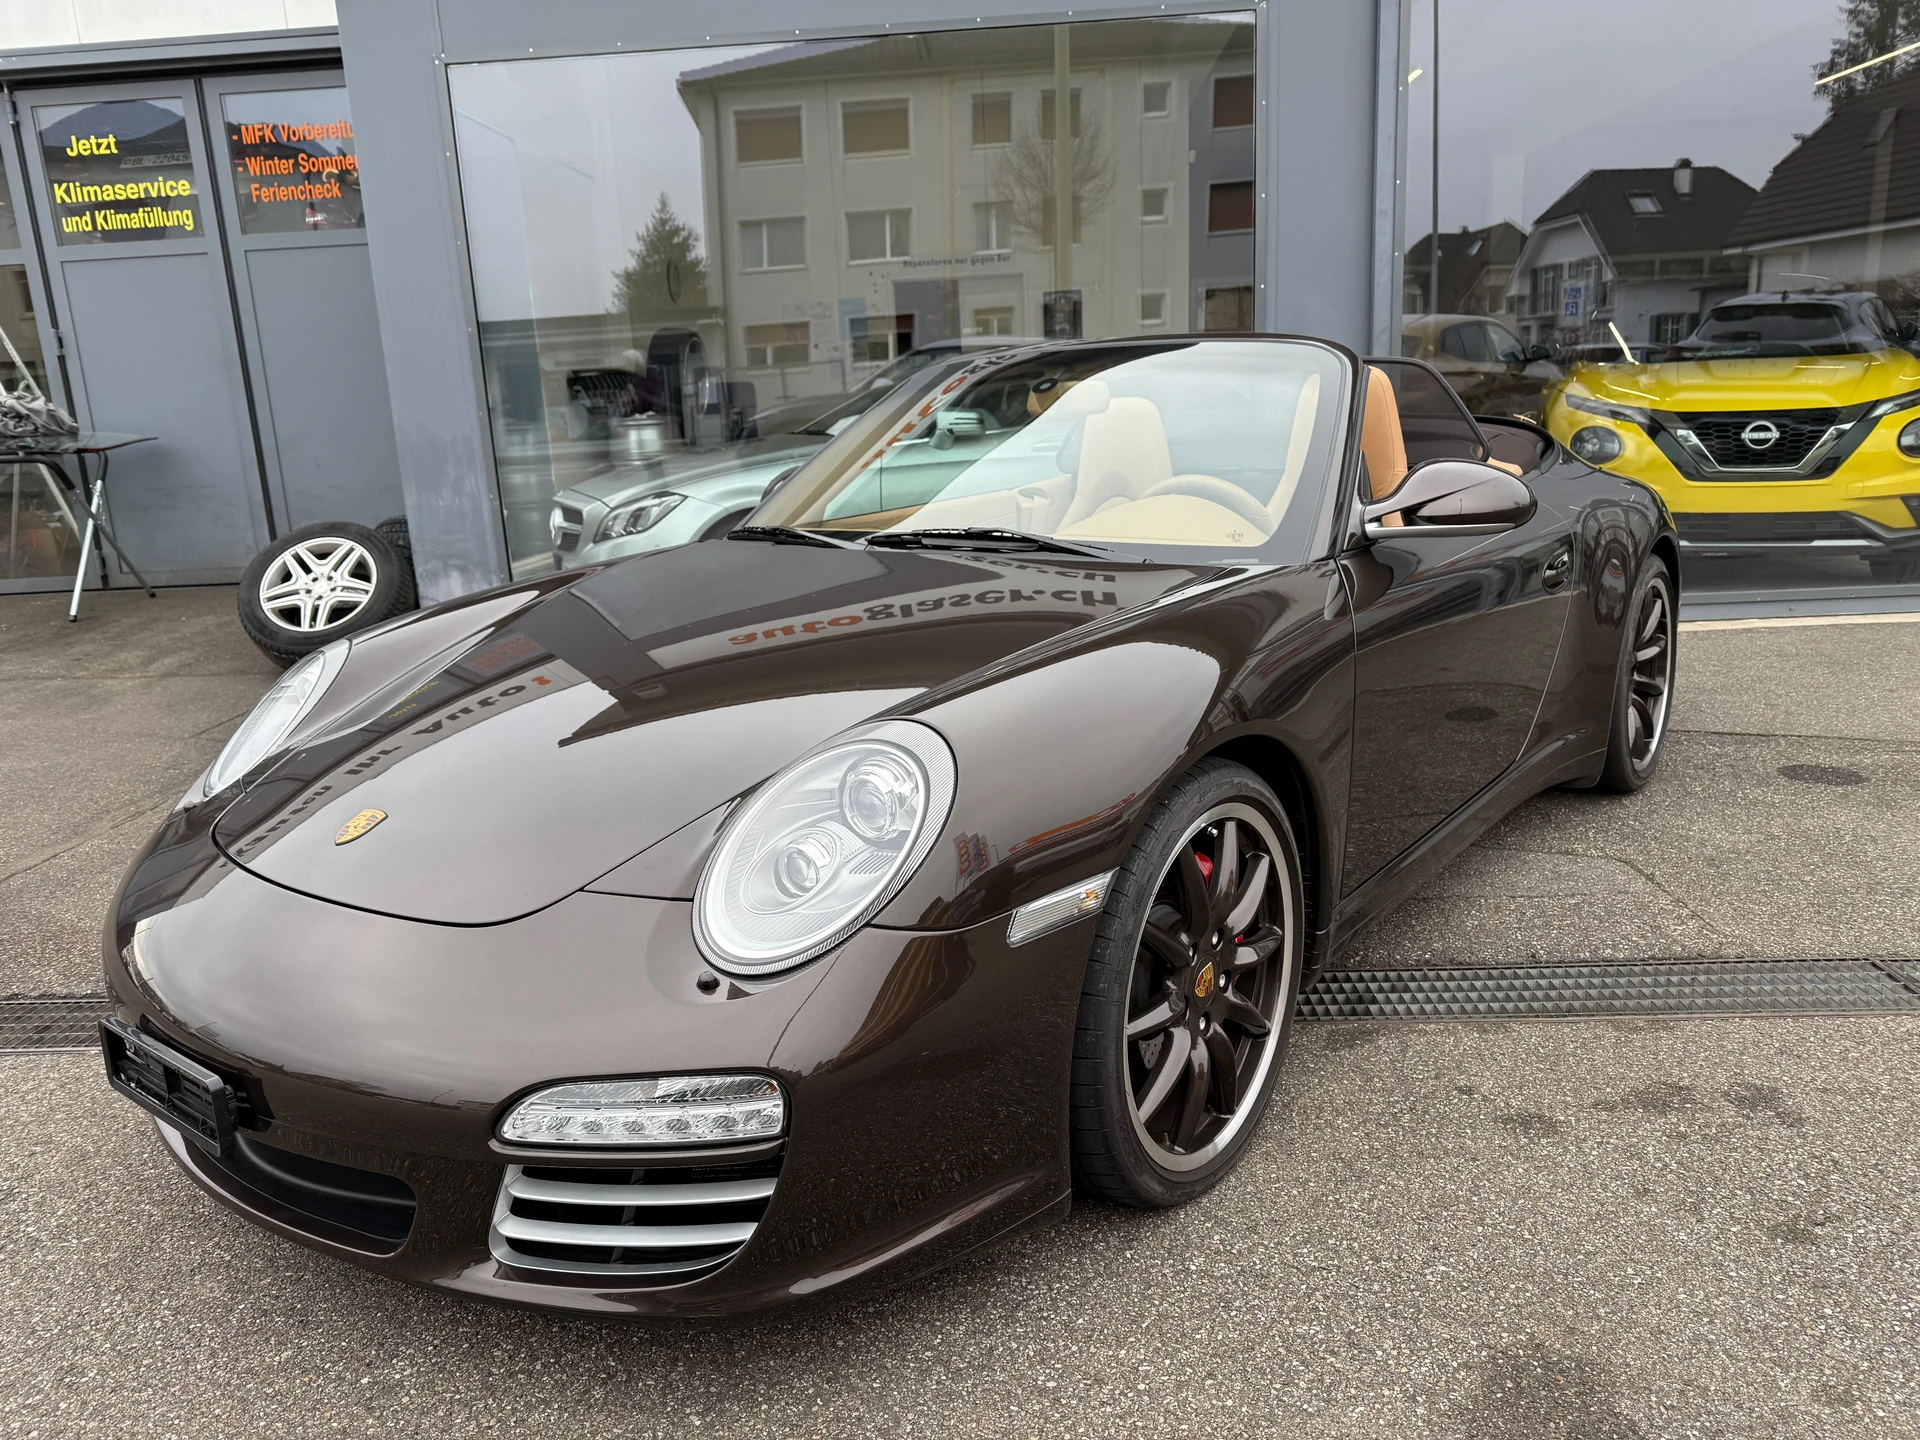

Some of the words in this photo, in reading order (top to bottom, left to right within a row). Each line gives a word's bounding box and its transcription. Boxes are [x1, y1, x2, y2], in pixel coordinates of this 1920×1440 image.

[66, 134, 118, 157] Jetzt
[241, 123, 277, 145] MFK
[245, 156, 295, 176] Winter
[54, 176, 191, 204] Klimaservice
[250, 178, 342, 203] Feriencheck
[62, 210, 92, 233] und
[95, 207, 194, 232] Klimafüllung
[1741, 432, 1780, 440] NISSAN
